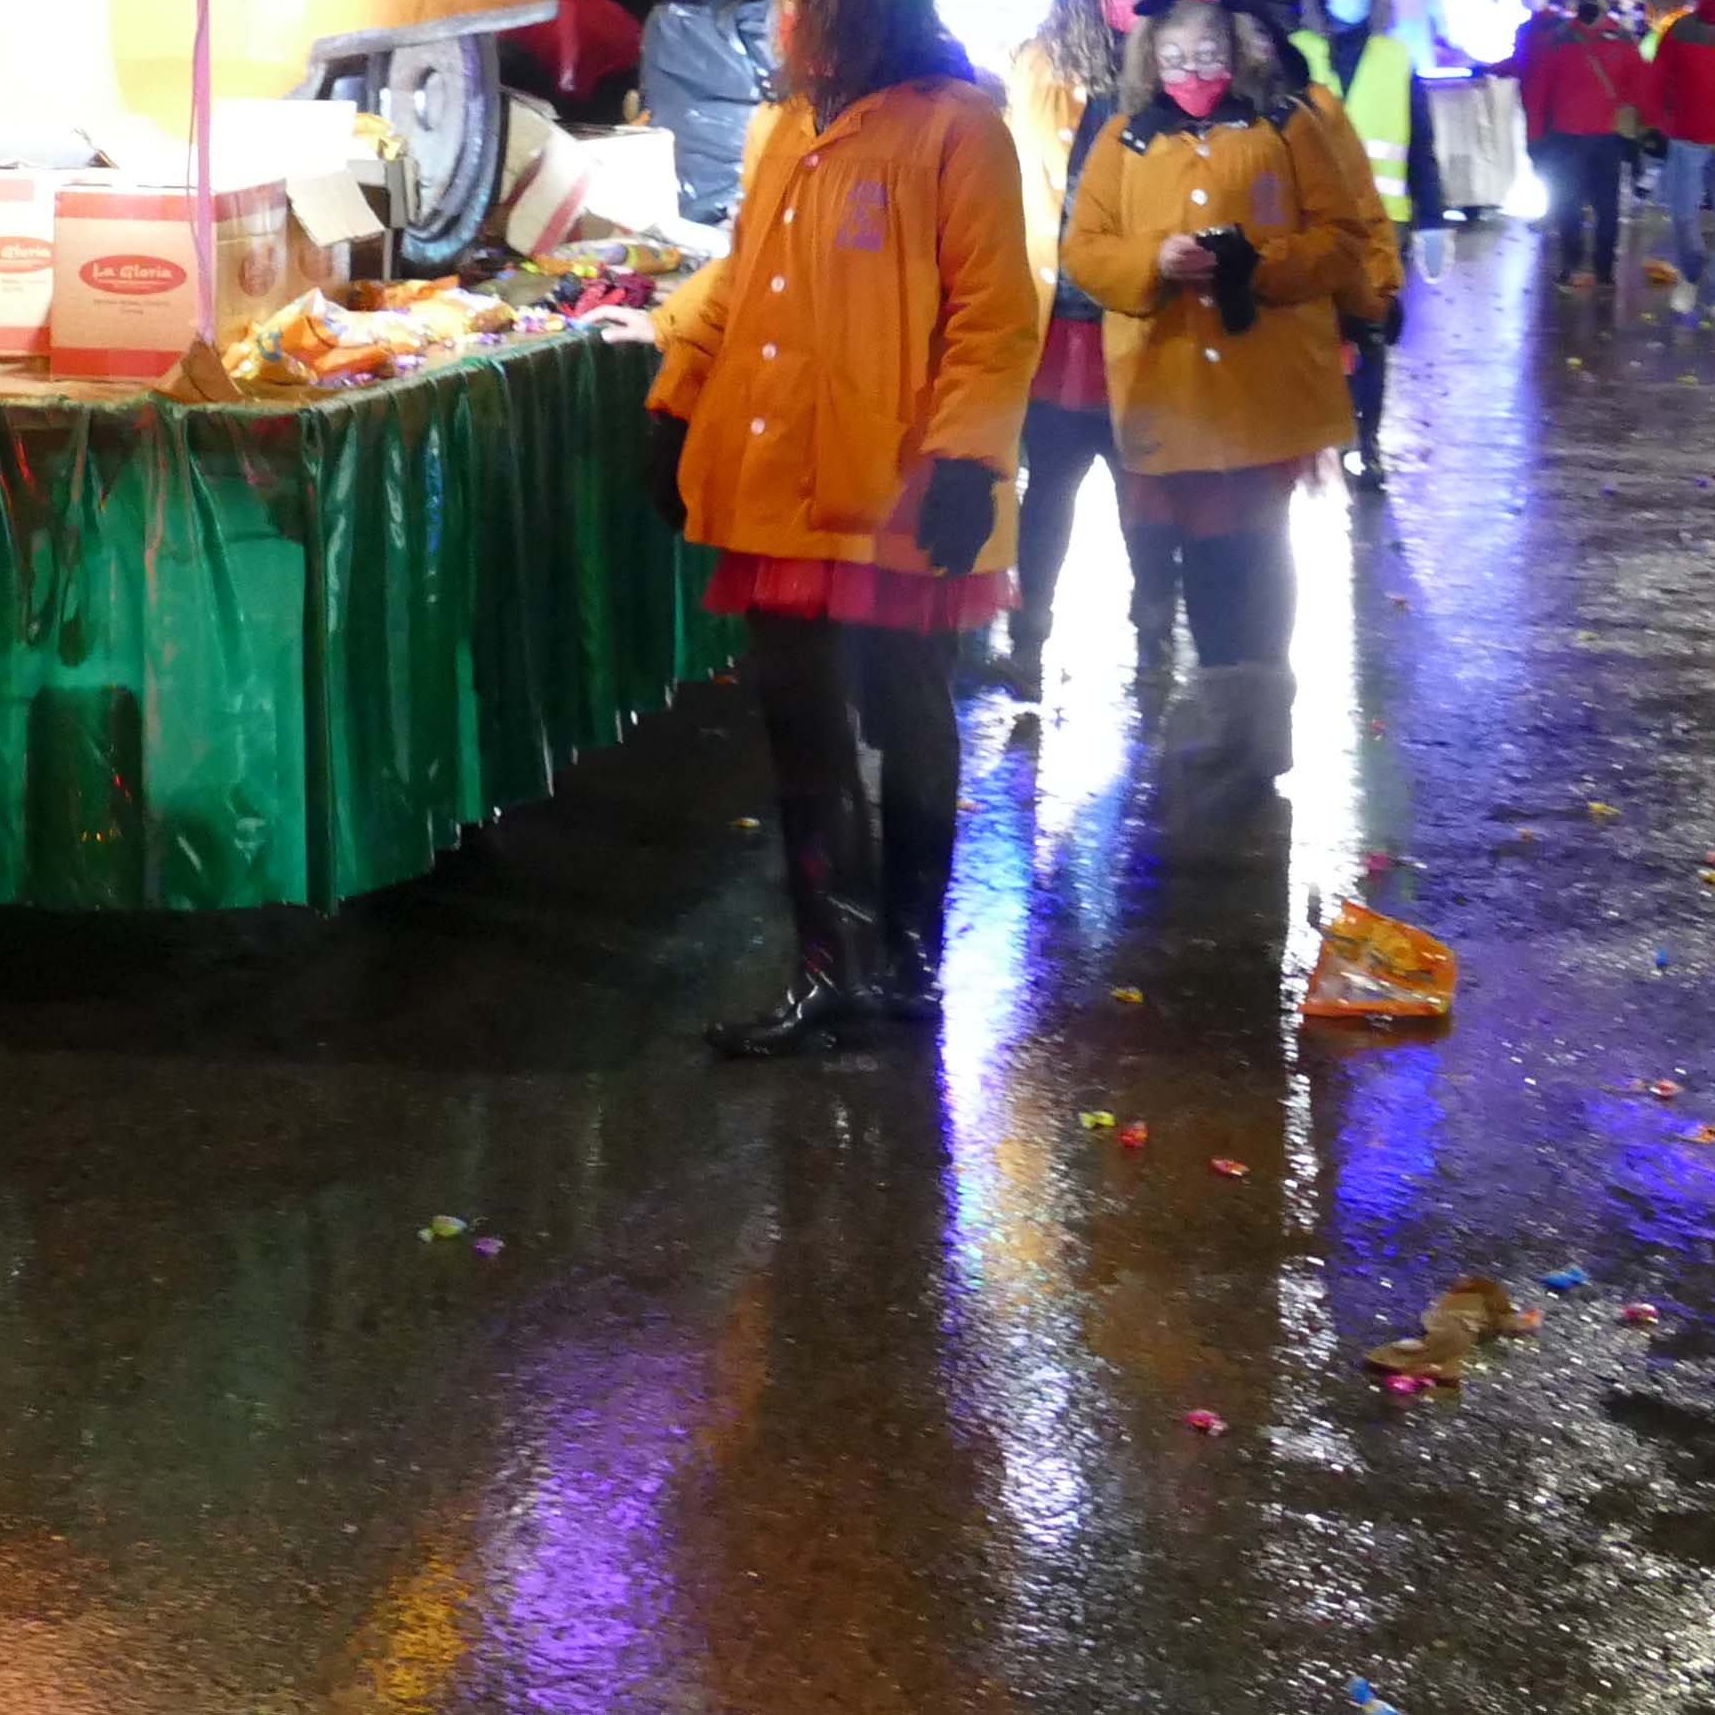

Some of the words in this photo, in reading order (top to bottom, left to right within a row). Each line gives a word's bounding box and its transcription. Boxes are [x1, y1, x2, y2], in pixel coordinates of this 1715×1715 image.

[0, 242, 52, 260] Gloria
[92, 262, 116, 278] La
[119, 264, 172, 279] Gloria
